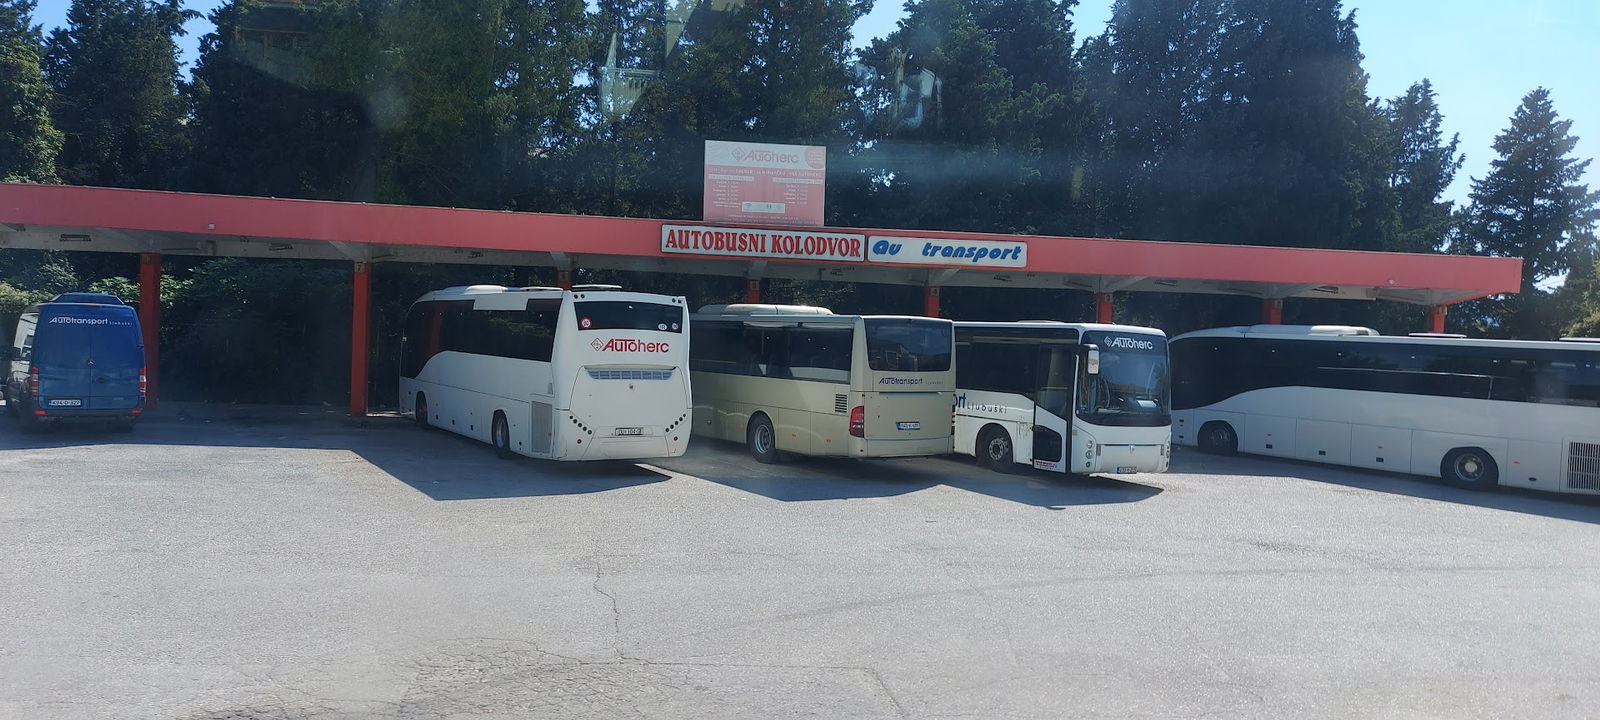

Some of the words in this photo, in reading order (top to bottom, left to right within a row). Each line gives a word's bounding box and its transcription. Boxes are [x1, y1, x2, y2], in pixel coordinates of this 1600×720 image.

[665, 228, 767, 253] AUTOBUSNI
[771, 232, 862, 258] KOLODVOR
[922, 242, 1022, 262] transport
